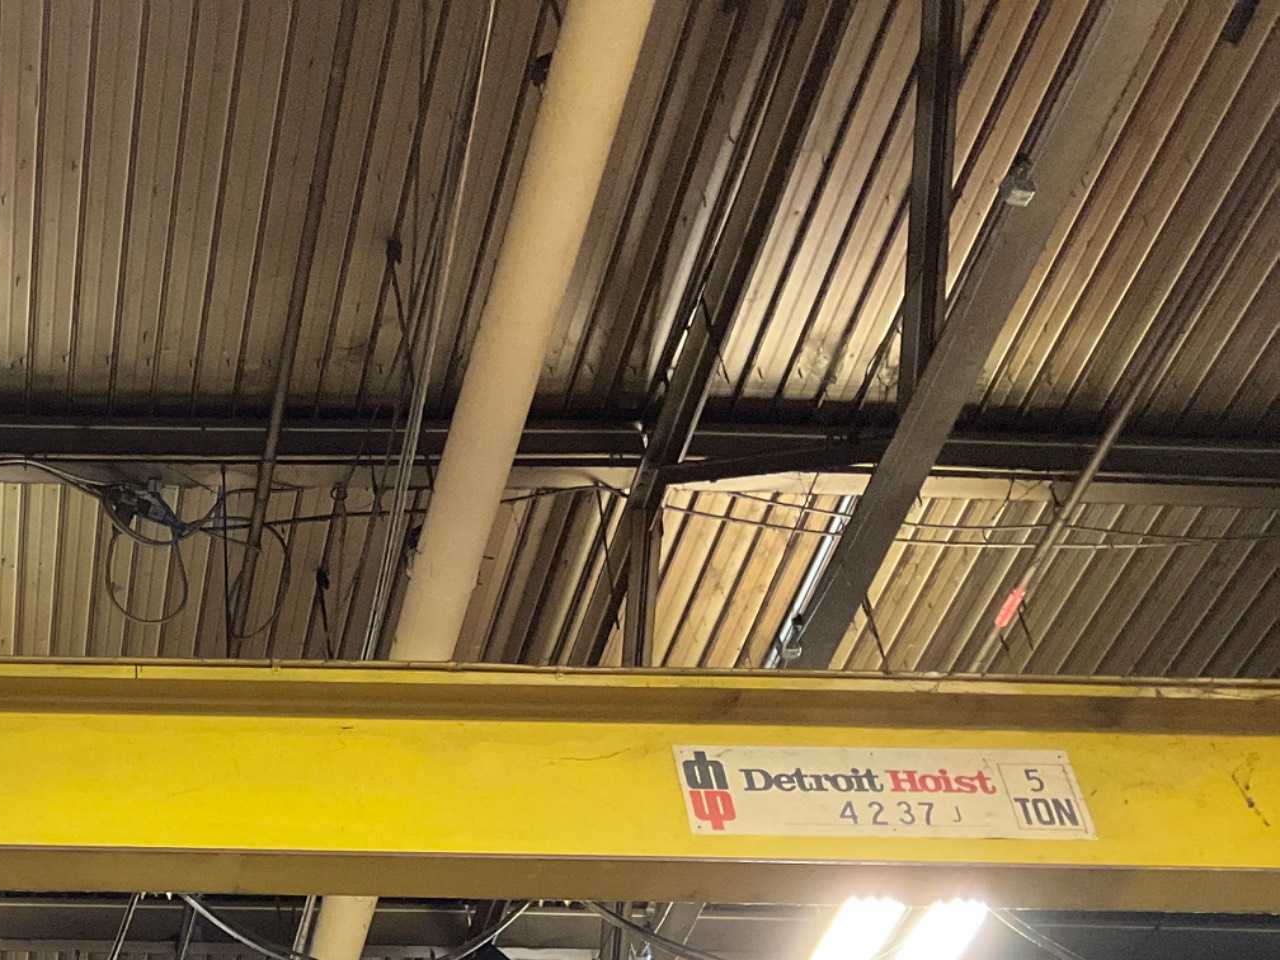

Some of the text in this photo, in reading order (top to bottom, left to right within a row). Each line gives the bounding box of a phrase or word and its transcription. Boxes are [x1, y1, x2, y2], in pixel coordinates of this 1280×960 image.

[739, 768, 997, 794] Detroit Hoist
[1024, 768, 1045, 792] 5
[1014, 797, 1079, 825] TON
